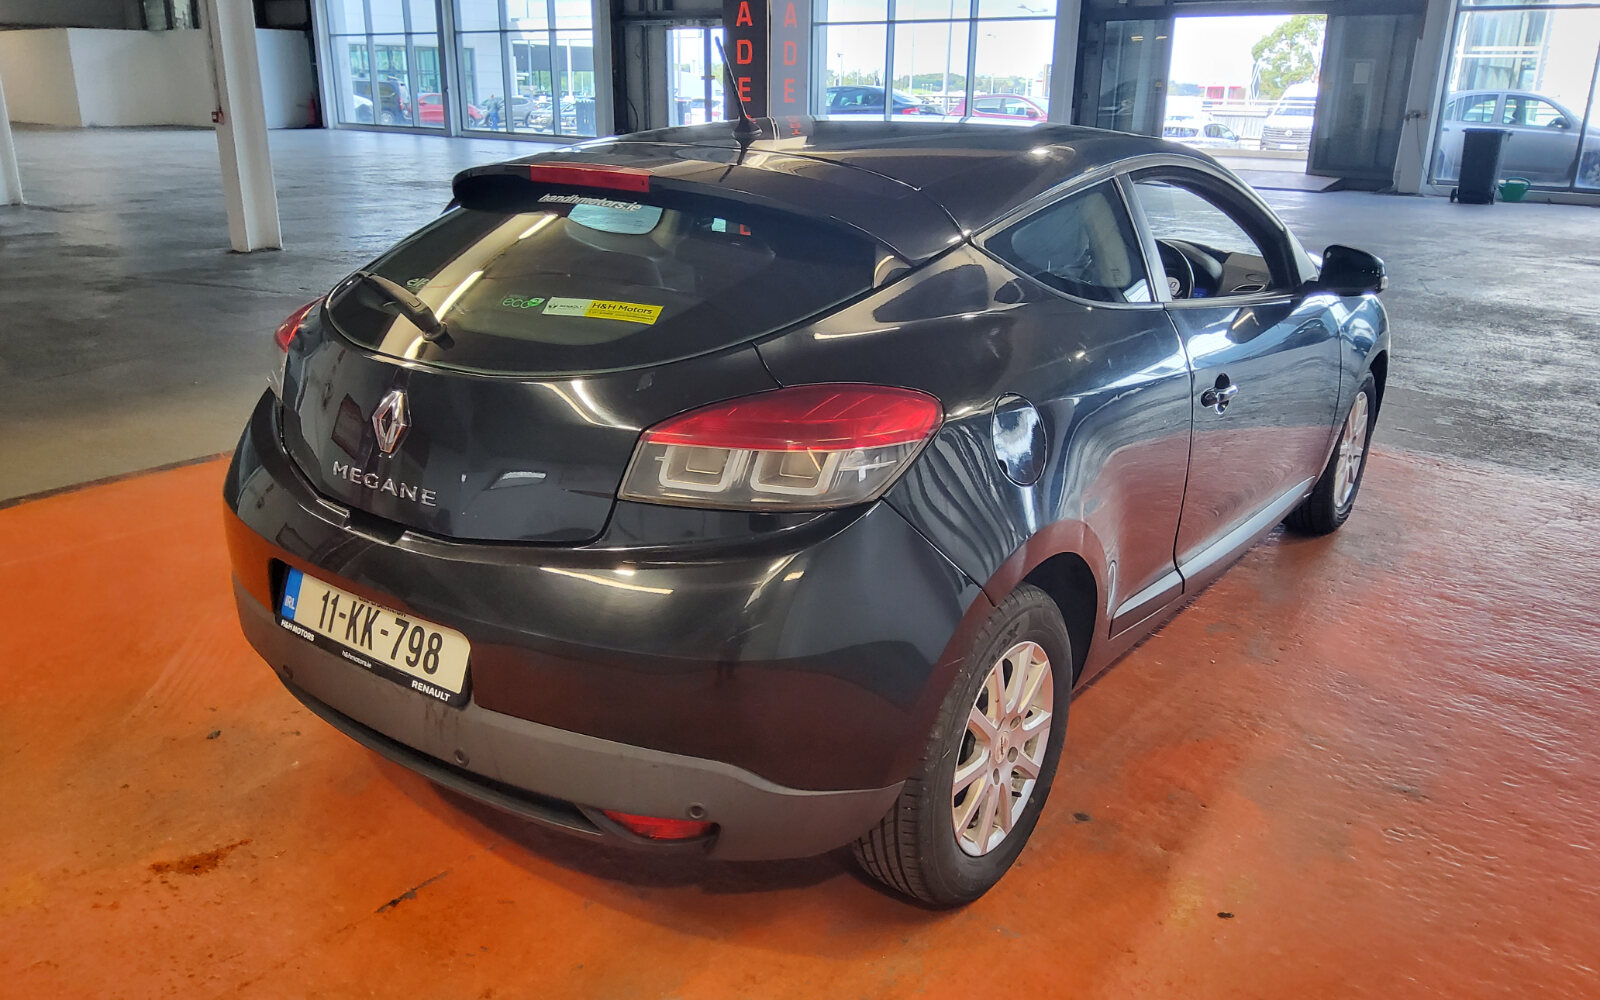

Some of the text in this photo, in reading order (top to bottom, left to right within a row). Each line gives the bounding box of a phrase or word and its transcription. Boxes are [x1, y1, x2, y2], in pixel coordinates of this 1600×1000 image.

[537, 193, 642, 211] handhmotors.ie
[592, 302, 653, 315] H&H Motors
[332, 460, 437, 507] MEGANE
[284, 594, 295, 610] IRL
[281, 619, 315, 642] H&H MOTORS
[319, 590, 443, 675] 11-KK-798
[411, 679, 451, 702] RENAULT
